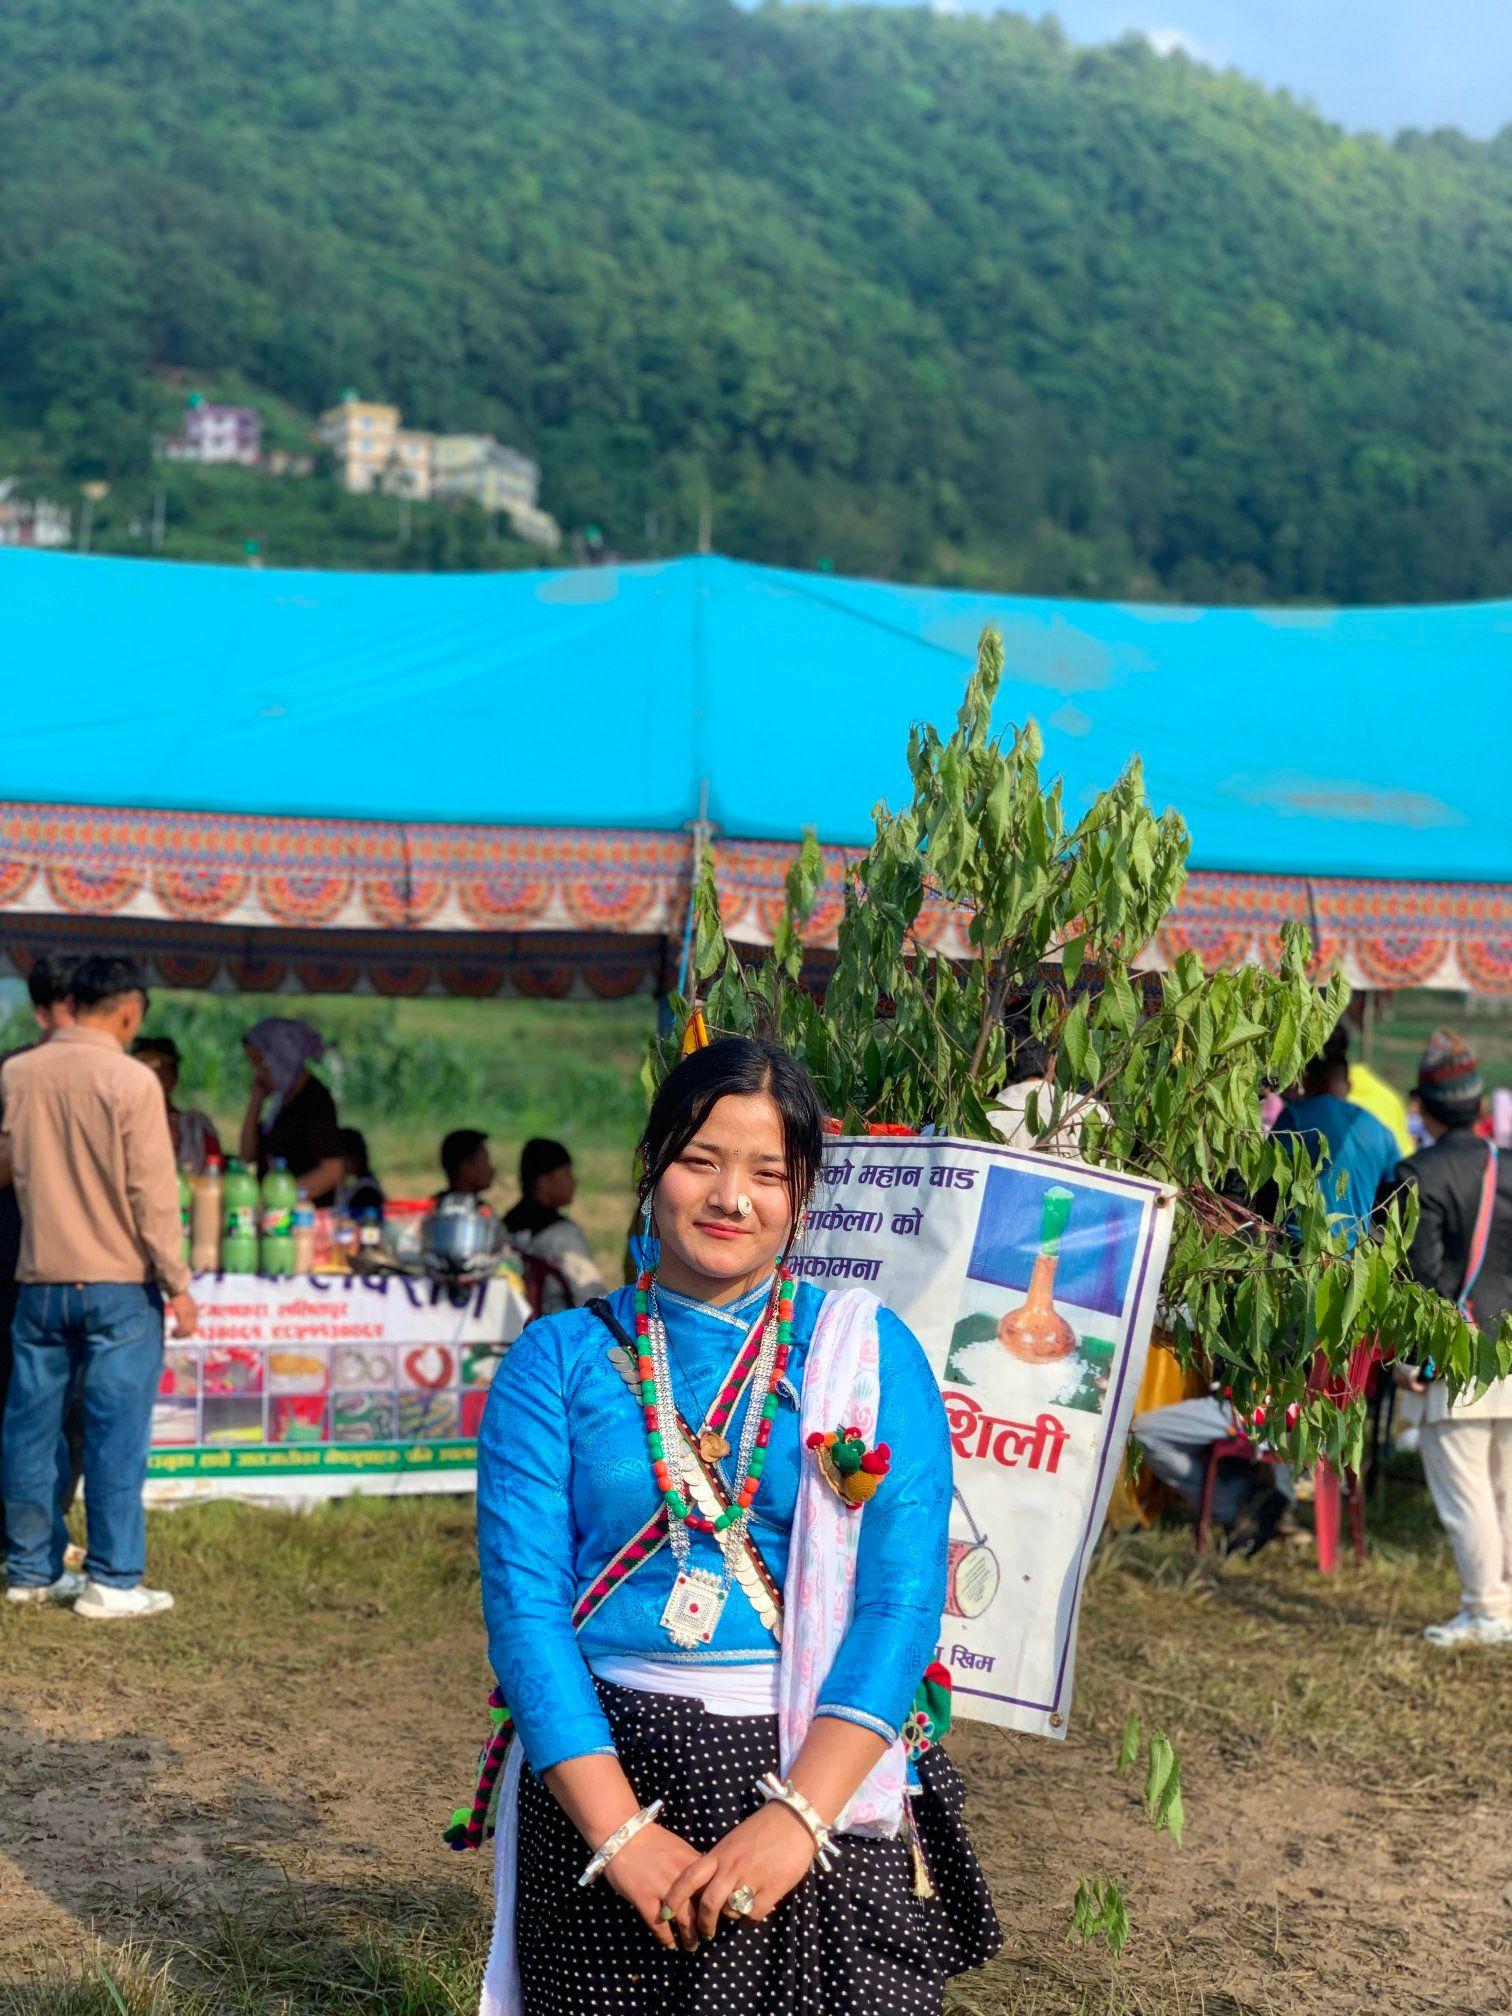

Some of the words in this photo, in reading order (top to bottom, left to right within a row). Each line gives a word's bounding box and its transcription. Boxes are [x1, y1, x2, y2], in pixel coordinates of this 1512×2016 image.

[819, 1159, 856, 1186] को
[858, 1165, 924, 1189] महान
[928, 1166, 980, 1190] चाड
[890, 1207, 924, 1236] को
[787, 1255, 884, 1281] भकामना
[949, 1644, 997, 1673] खिम
